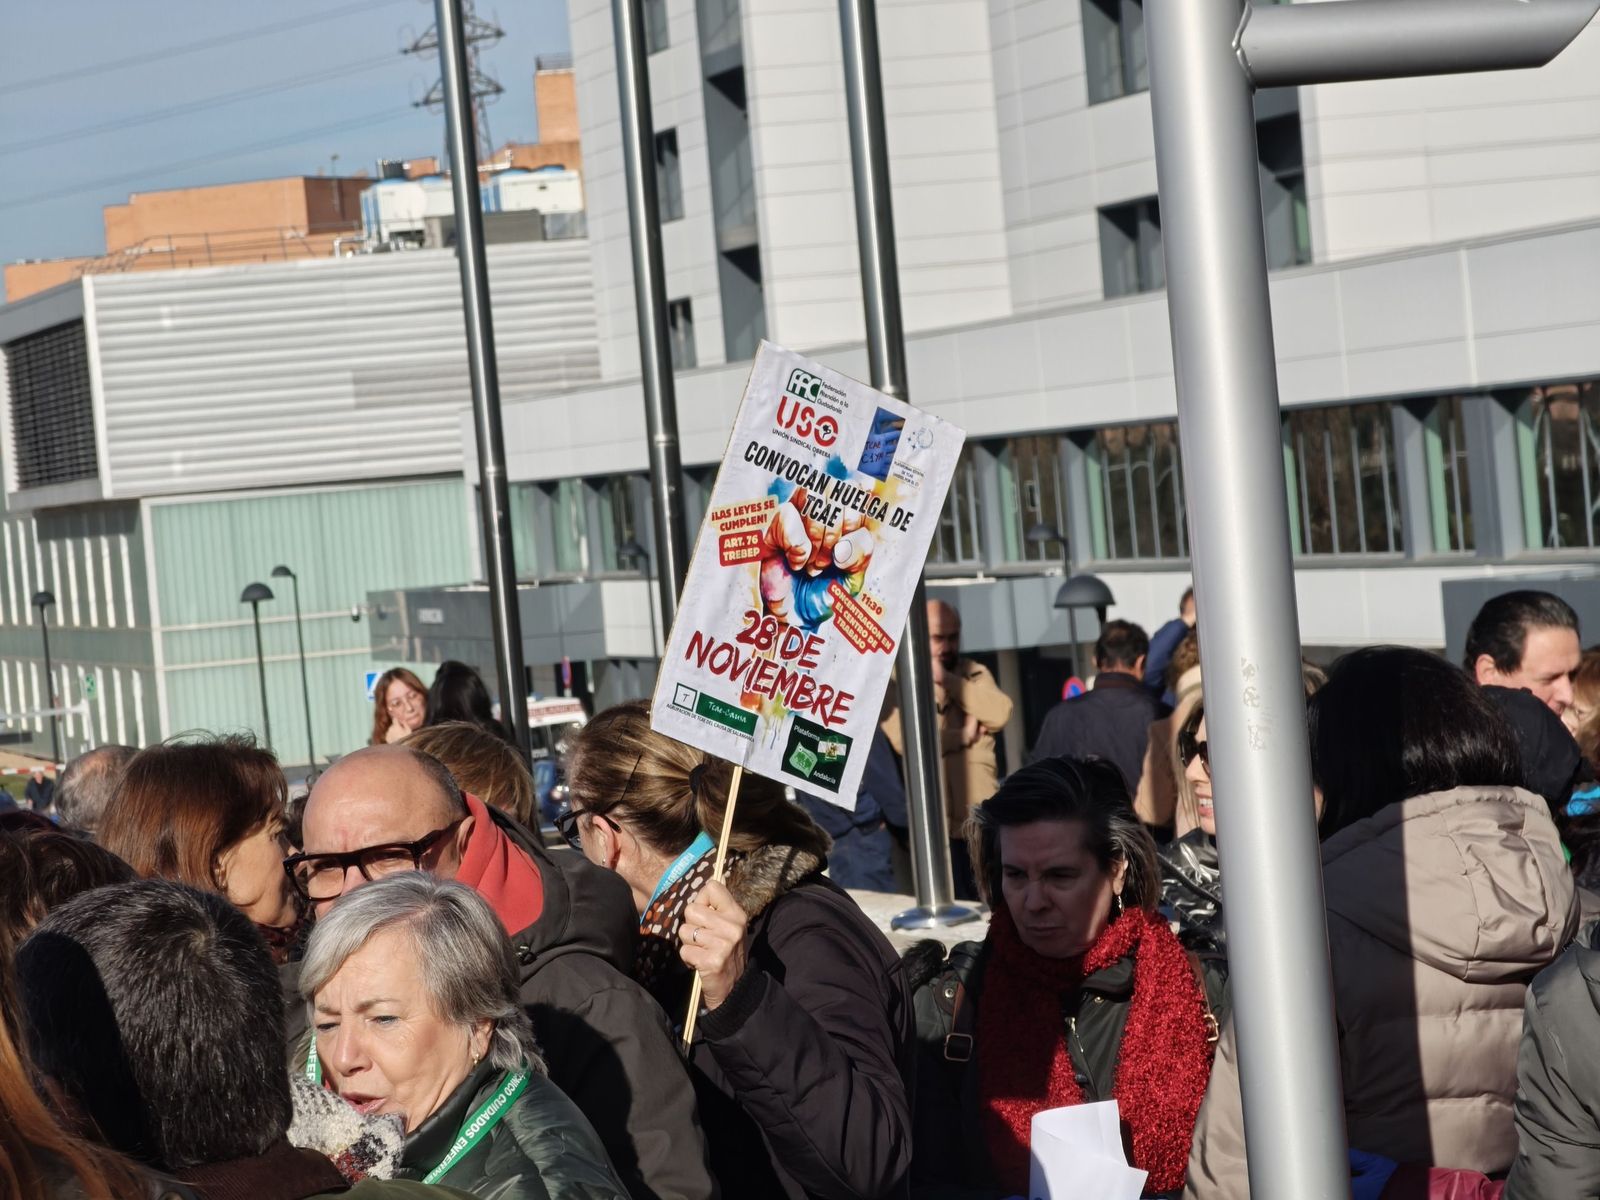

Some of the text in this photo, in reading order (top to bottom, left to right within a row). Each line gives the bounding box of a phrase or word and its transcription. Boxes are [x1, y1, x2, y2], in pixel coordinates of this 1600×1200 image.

[776, 395, 839, 447] USO
[772, 428, 831, 459] UNIÓN SINDICAL OBRERA
[744, 441, 914, 532] CONVOCAN HUELGA DE
[720, 514, 767, 531] CUMPLEN!
[734, 503, 761, 516] LEYES
[764, 500, 775, 510] SE
[802, 494, 842, 527] TCAE
[723, 547, 760, 561] TREBEP
[724, 535, 758, 548] ART. 76
[861, 593, 882, 615] 11:30
[735, 610, 825, 669] 28 DE
[835, 602, 878, 648] EL CENTRO DE
[837, 617, 866, 650] TRABAJO
[881, 637, 892, 650] EN
[684, 630, 855, 727] NOVIEMBRE
[793, 725, 820, 741] Plataforma
[465, 1093, 507, 1139] CUIDADOS
